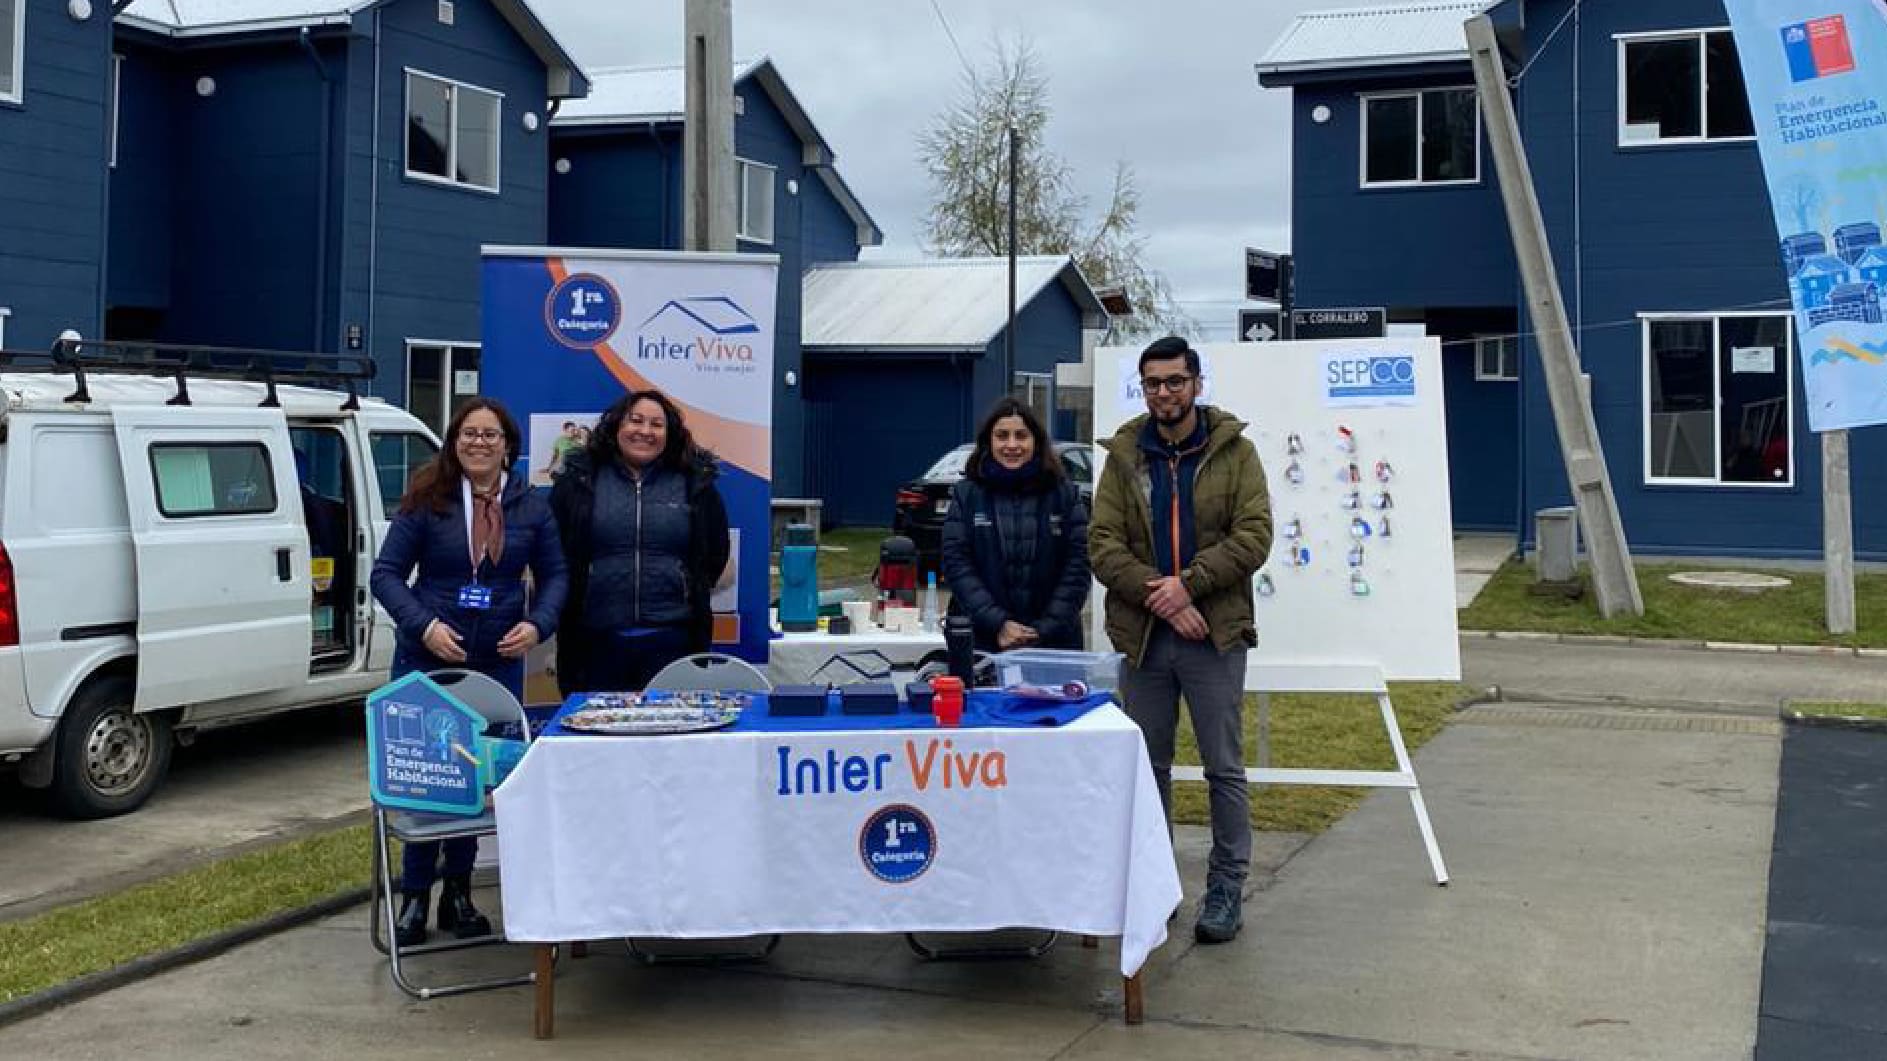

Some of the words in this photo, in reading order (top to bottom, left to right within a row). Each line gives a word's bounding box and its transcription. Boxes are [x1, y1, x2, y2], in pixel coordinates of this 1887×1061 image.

[1778, 99, 1878, 129] Emergencia
[1781, 110, 1887, 143] Habitacional
[1327, 357, 1414, 384] SEPCO
[386, 743, 410, 756] Plan
[410, 747, 424, 758] de
[386, 755, 461, 775] Emergencia
[386, 767, 467, 789] Habitacional
[777, 745, 892, 795] Inter
[906, 738, 1007, 791] Viva
